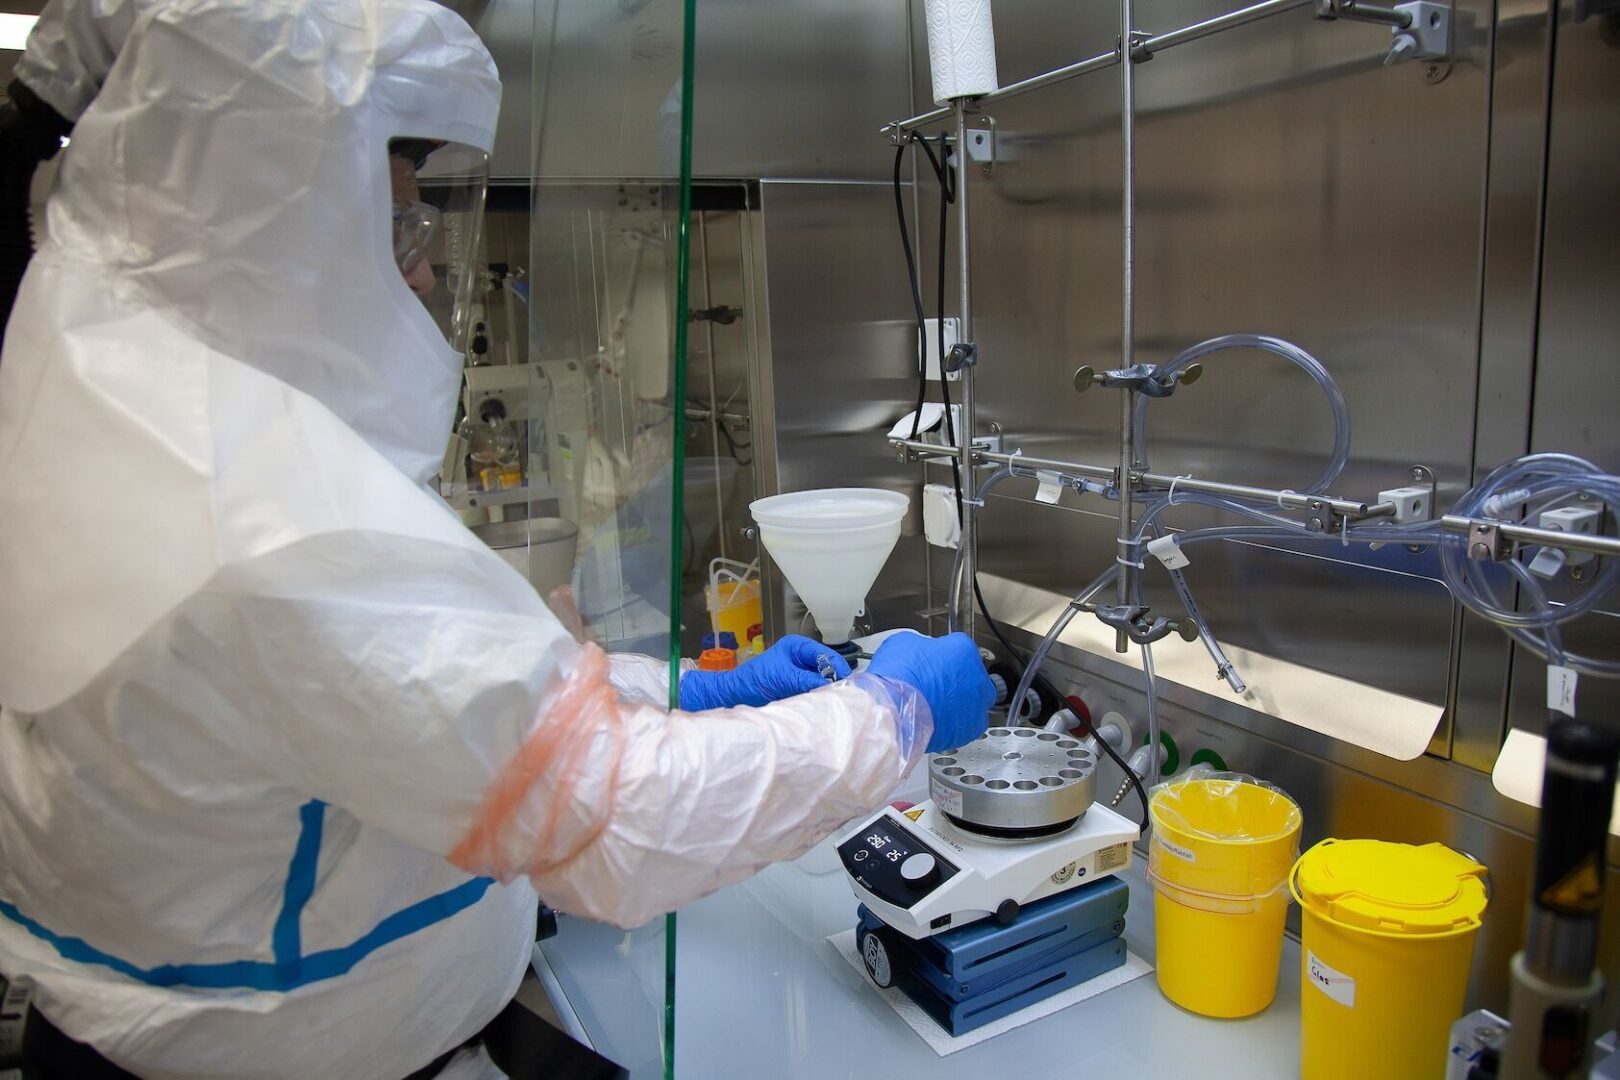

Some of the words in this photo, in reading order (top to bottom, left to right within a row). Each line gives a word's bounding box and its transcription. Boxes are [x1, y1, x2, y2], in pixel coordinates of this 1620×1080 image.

[867, 834, 886, 849] 290
[886, 849, 902, 862] 25
[869, 938, 878, 969] BOY
